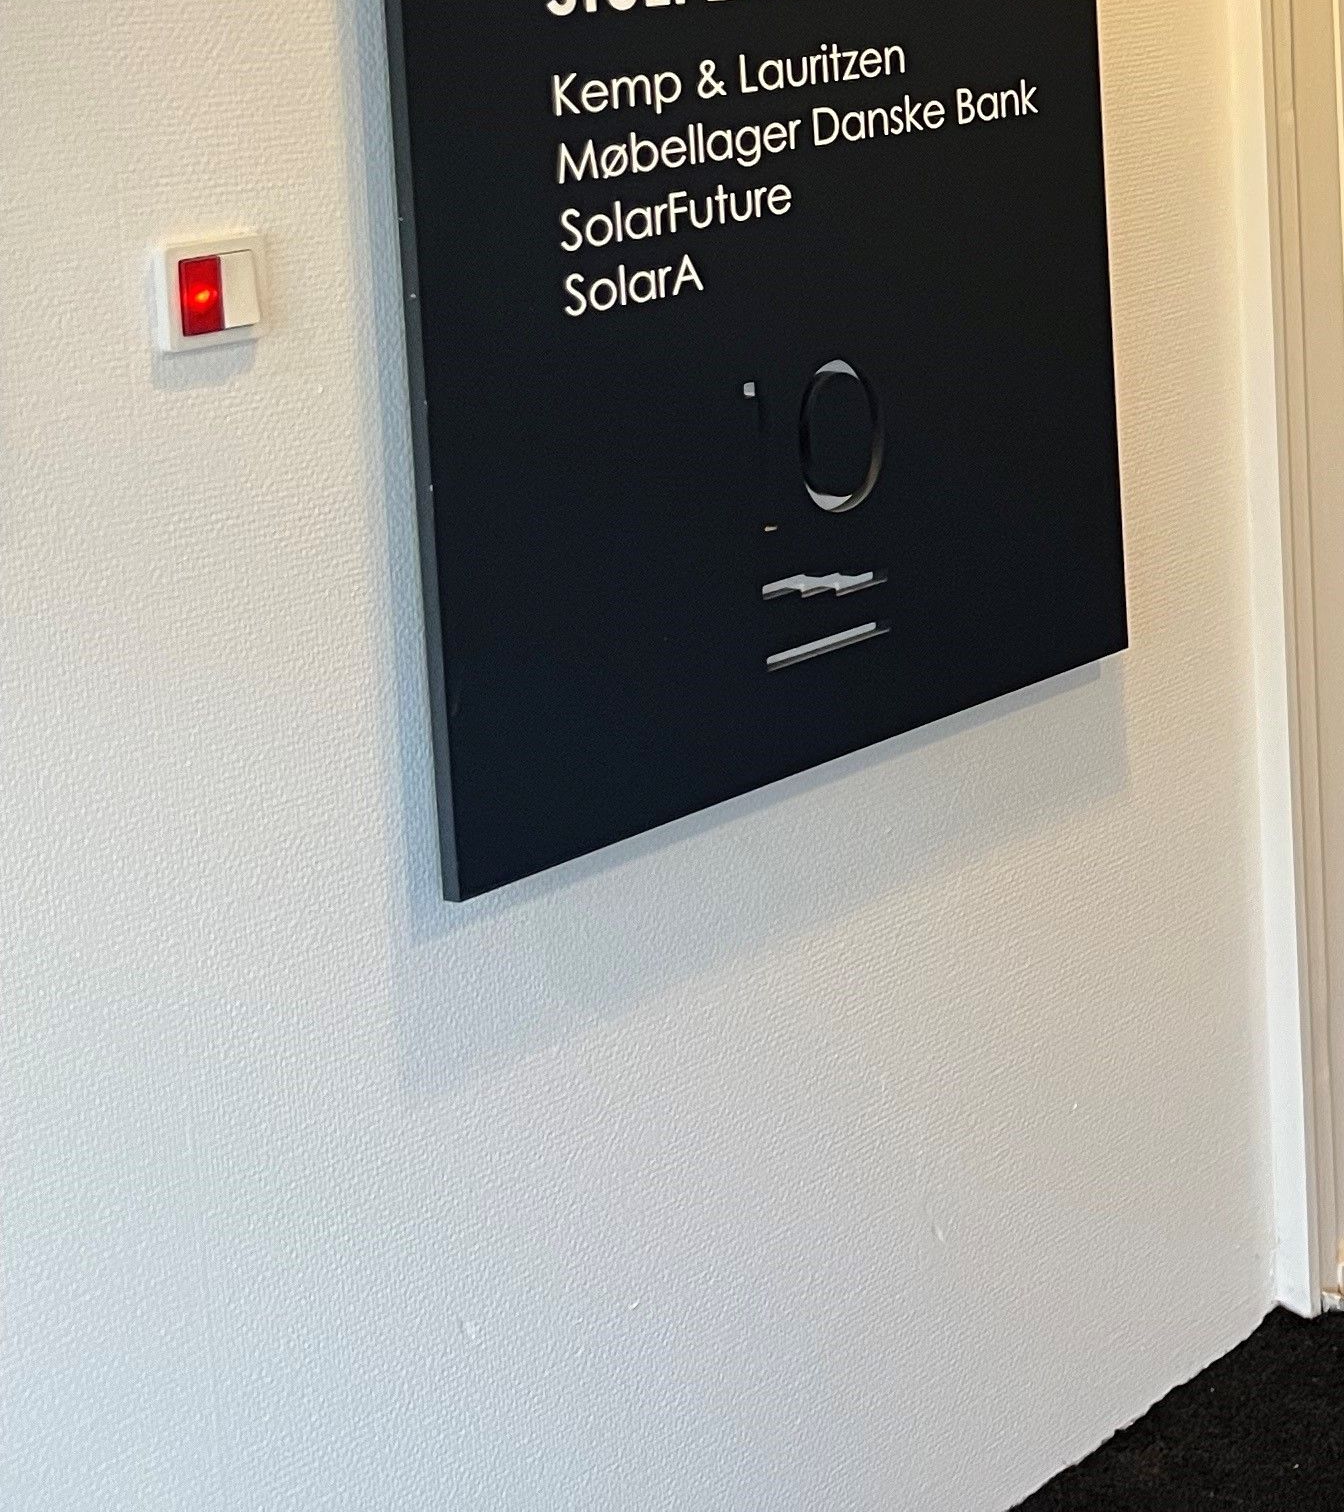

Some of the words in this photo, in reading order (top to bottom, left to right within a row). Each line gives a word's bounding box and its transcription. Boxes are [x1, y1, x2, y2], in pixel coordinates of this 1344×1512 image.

[553, 71, 683, 117] Kemp
[696, 59, 728, 100] &
[738, 43, 906, 94] Lauritzen
[557, 114, 802, 185] Møbellager
[812, 94, 947, 147] Danske
[956, 78, 1039, 125] Bank
[560, 183, 793, 253] SolarFuture
[564, 253, 705, 317] SolarA
[742, 357, 886, 534] 0
